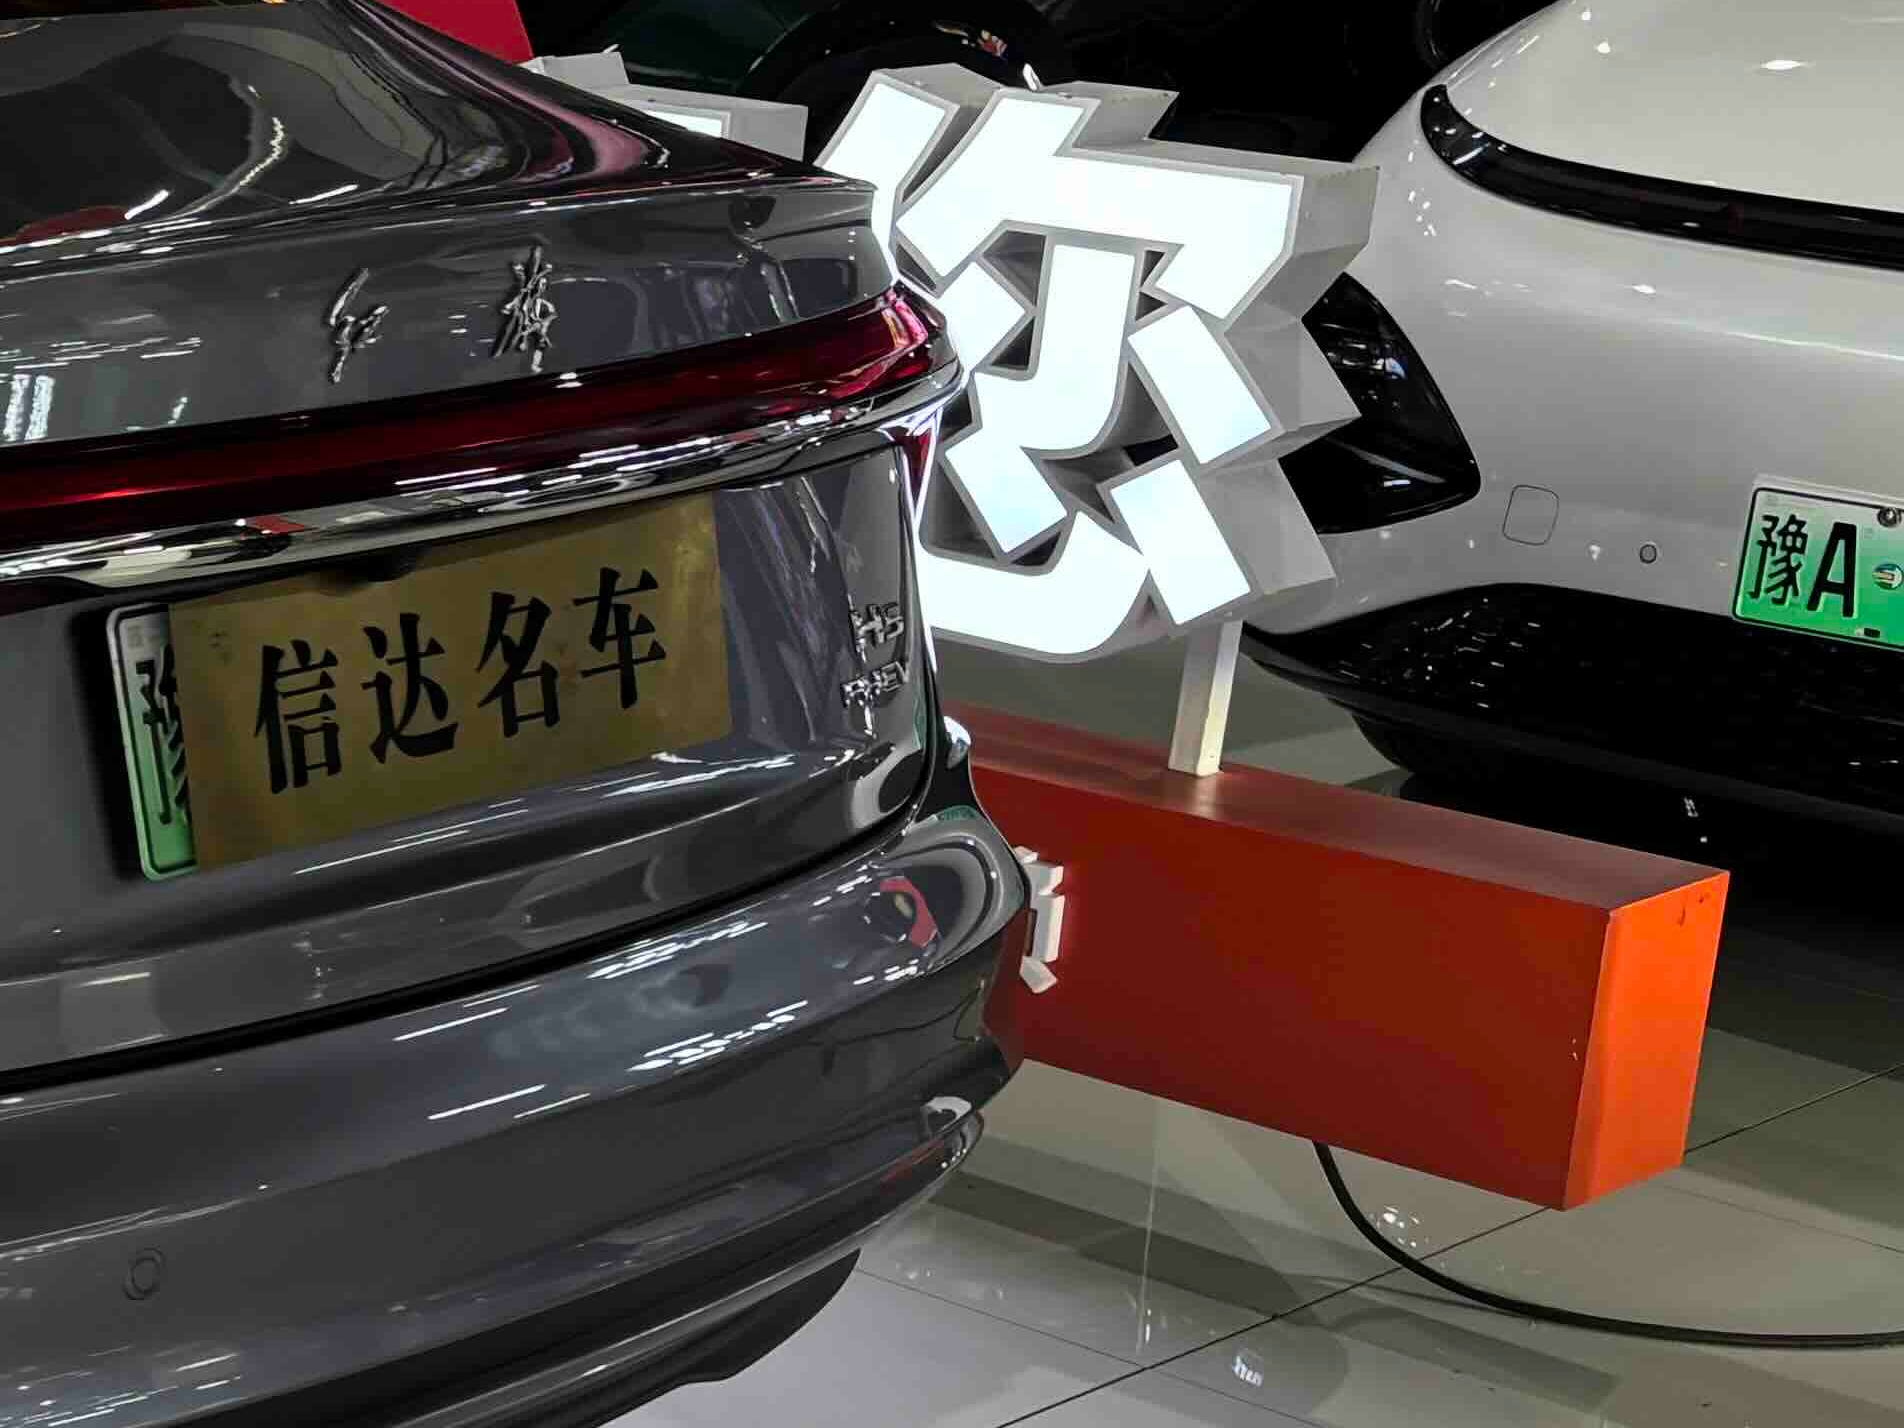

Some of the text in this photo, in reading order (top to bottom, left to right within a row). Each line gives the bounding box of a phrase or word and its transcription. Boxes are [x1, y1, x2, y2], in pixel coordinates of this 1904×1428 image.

[1747, 512, 1859, 619] 豫A
[254, 567, 666, 794] 信达名车
